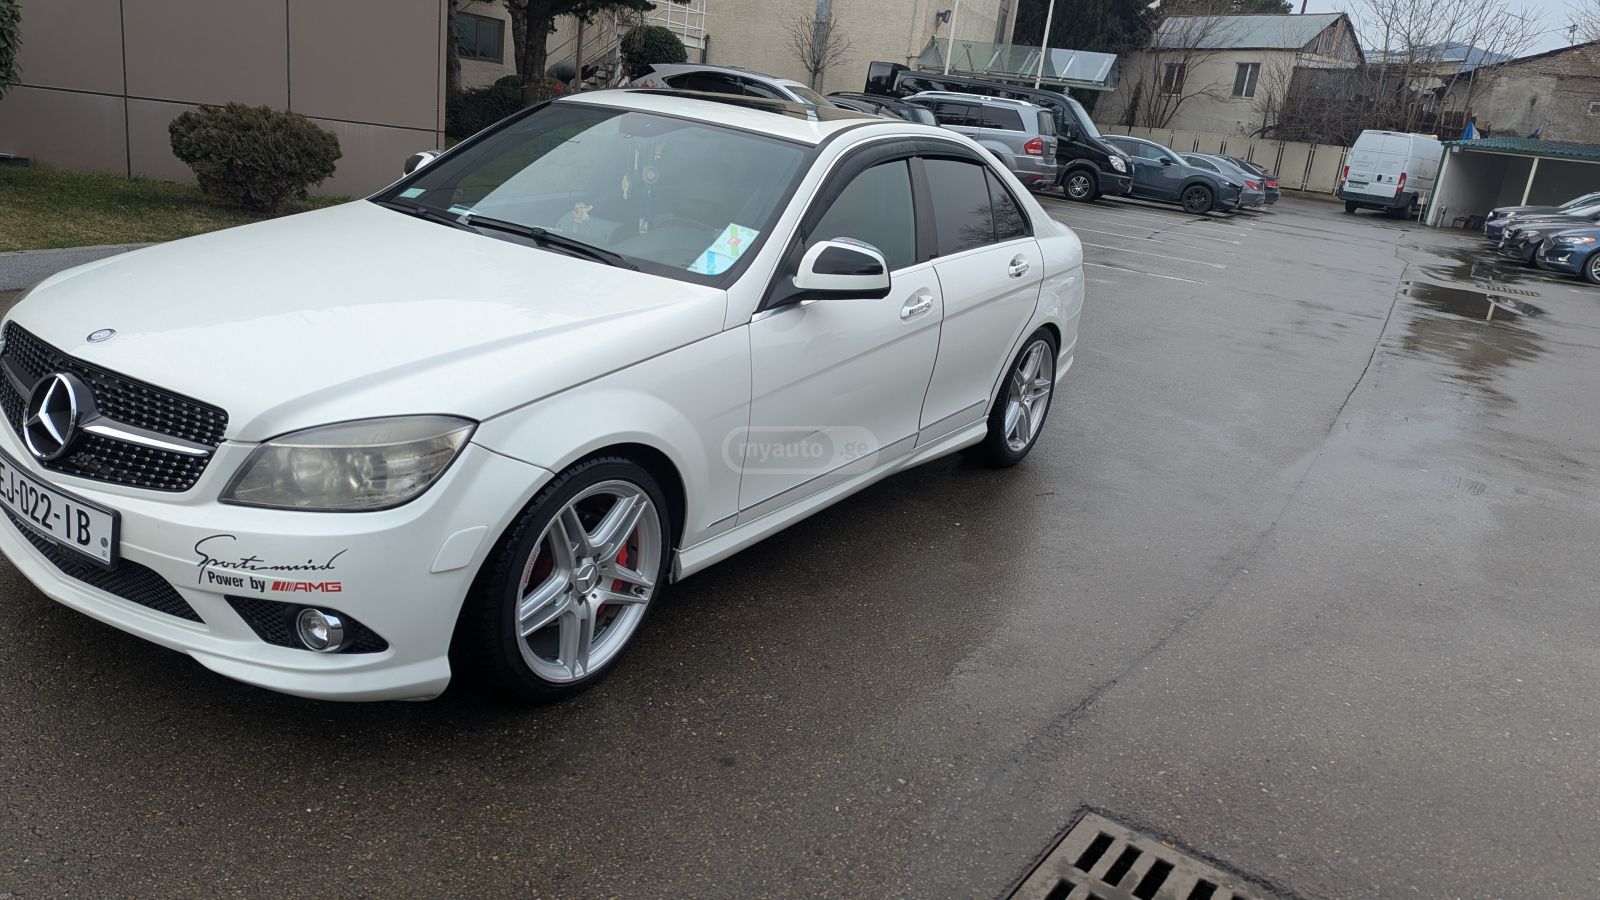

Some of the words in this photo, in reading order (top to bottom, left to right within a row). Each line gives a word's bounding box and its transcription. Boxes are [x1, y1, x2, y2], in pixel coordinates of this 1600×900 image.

[207, 571, 244, 588] Power
[249, 576, 266, 593] by
[293, 581, 342, 593] AMG
